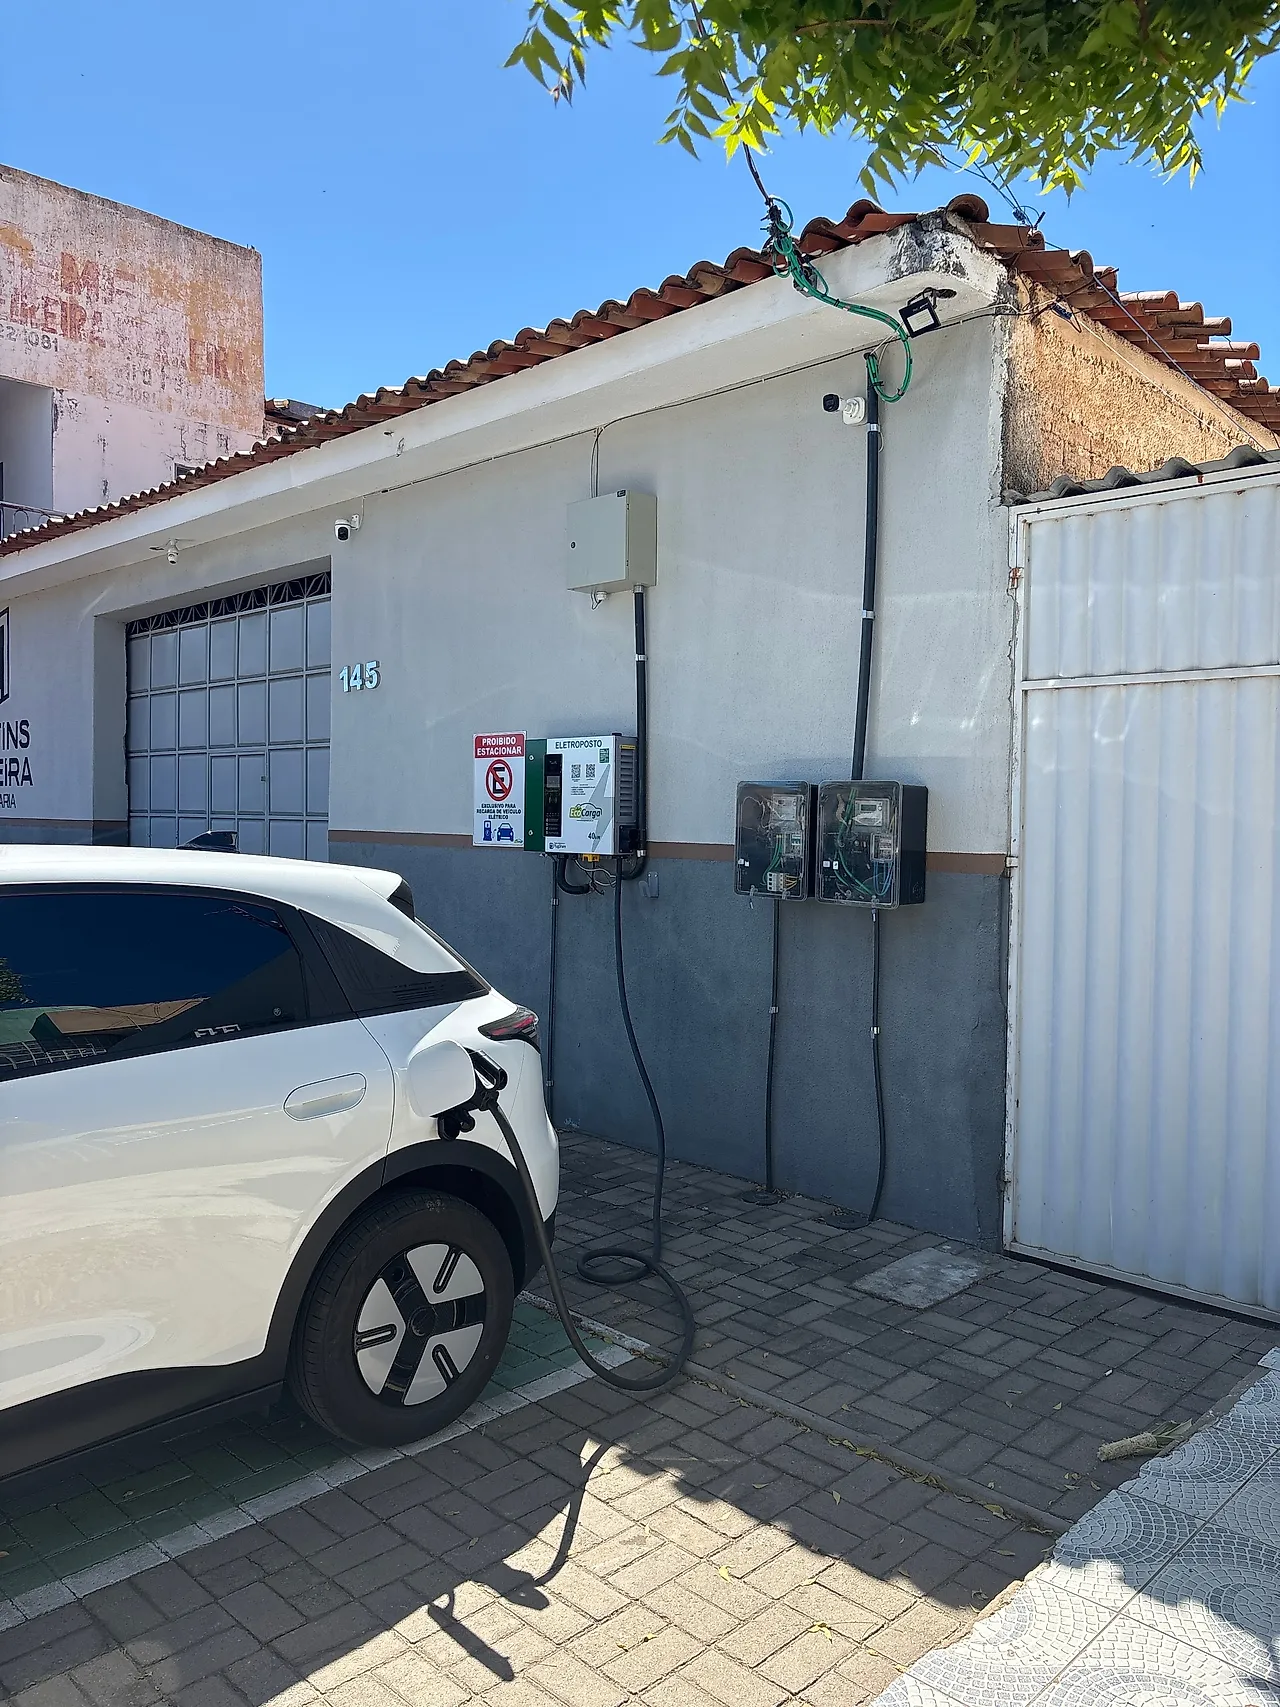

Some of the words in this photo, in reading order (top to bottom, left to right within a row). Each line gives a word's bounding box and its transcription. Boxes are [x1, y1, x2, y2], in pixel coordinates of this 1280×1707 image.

[339, 660, 380, 692] 145
[0, 719, 30, 750] INS
[482, 737, 516, 746] PROIBIDO
[555, 740, 602, 749] ELETROPOSTO
[477, 746, 522, 756] ESTACIONAR
[570, 808, 601, 819] EcoCarga
